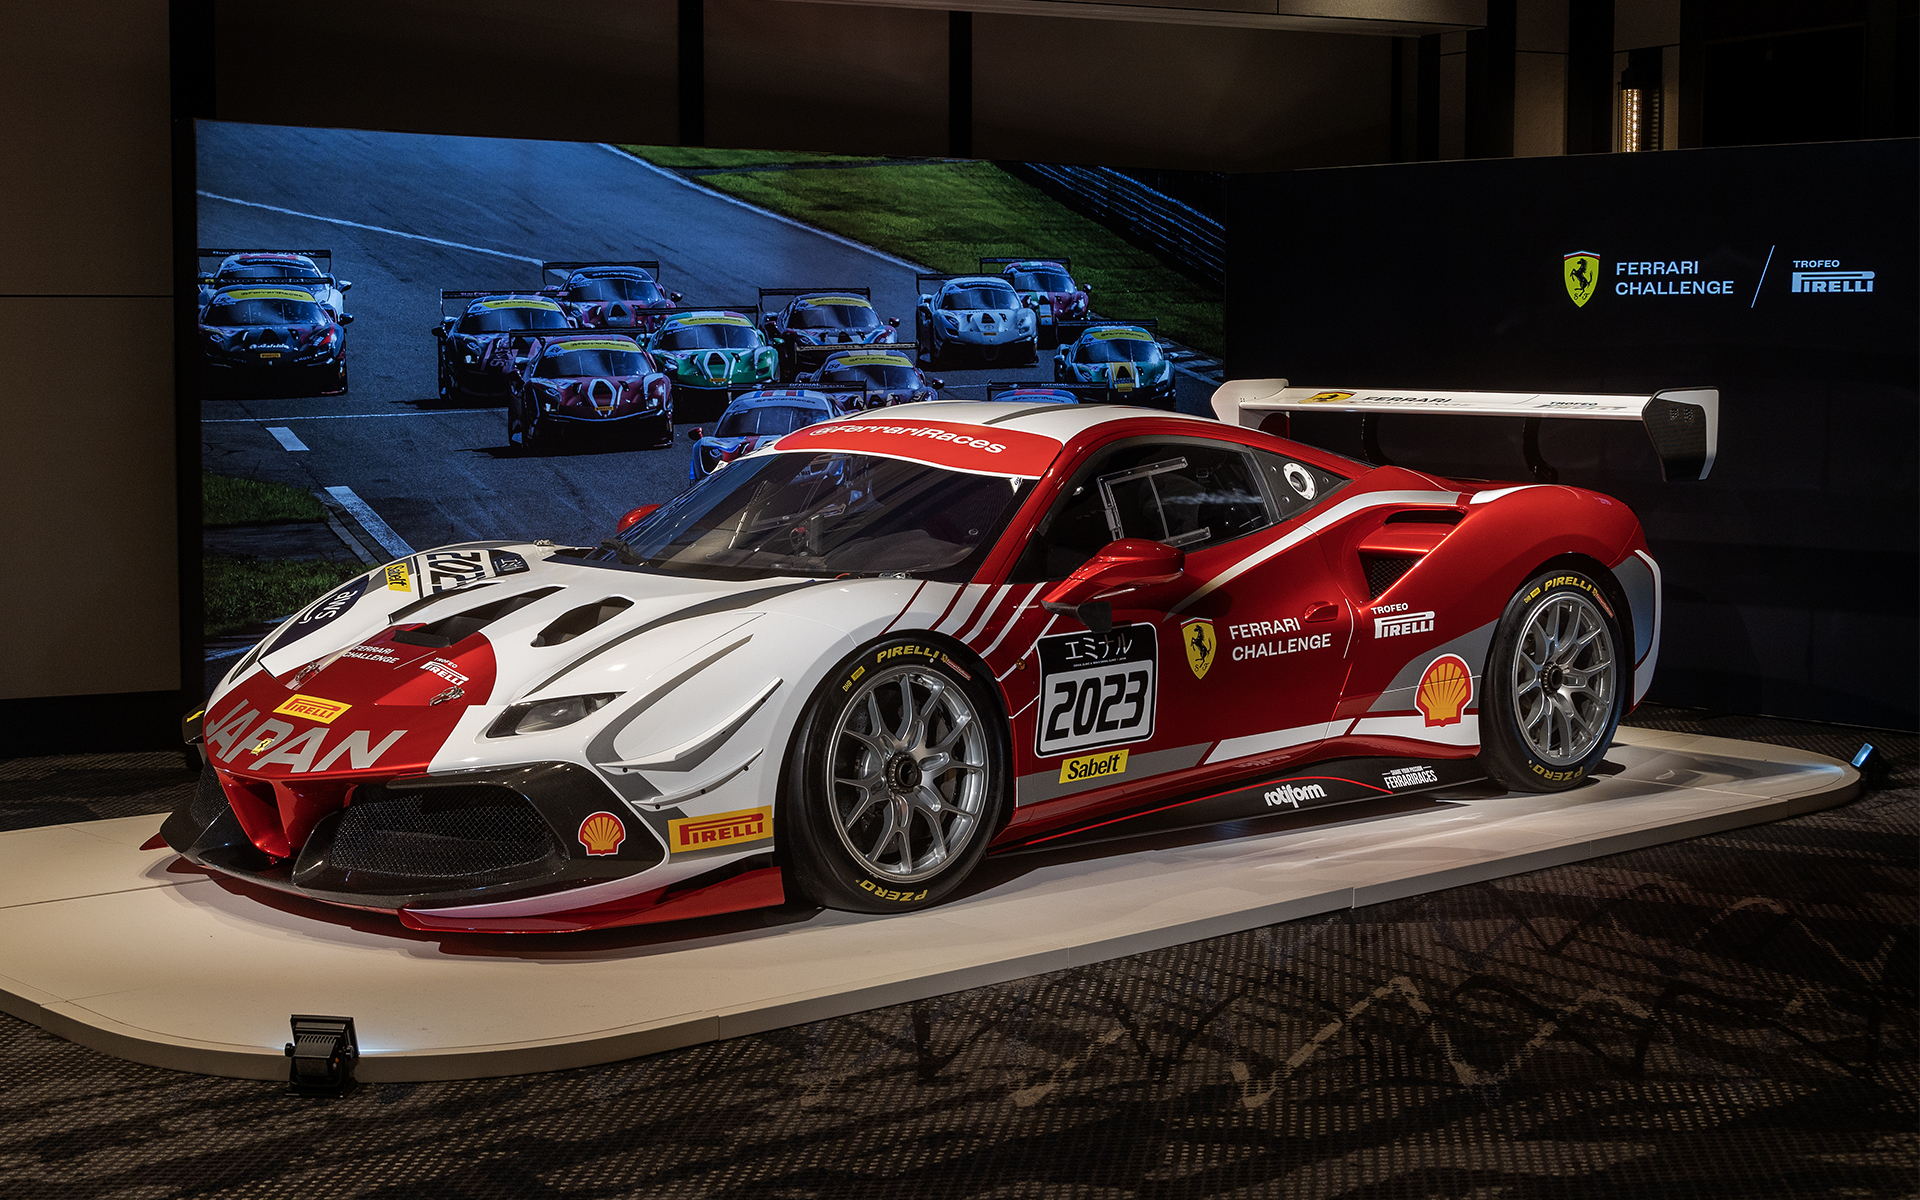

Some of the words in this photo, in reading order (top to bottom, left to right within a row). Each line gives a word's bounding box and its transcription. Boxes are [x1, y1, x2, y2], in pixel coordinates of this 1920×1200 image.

[1616, 260, 1700, 277] FERRARI
[1793, 259, 1841, 269] TROFEO
[1614, 280, 1735, 297] CHALLENGE
[1791, 270, 1877, 294] PIRELLI
[809, 424, 1007, 454] @FerrariRaces
[386, 564, 408, 587] Sabelt
[1544, 576, 1592, 592] PIRELLI
[314, 590, 359, 620] aws
[1370, 602, 1409, 616] TROFEO
[1228, 616, 1301, 640] FERRARI
[1374, 610, 1436, 640] PIRELLI
[342, 652, 400, 664] CHALLENGE
[876, 644, 940, 664] PIRELLI
[1064, 633, 1133, 660] エミナル
[1231, 632, 1332, 662] CHALLENGE
[419, 660, 470, 686] PIRELLI
[434, 657, 458, 669] TROFEO
[284, 698, 342, 719] PIRELLI
[1044, 669, 1149, 742] 2023
[205, 698, 409, 774] JAPAN
[1067, 753, 1122, 781] Sabelt
[1532, 764, 1584, 781] PZERO
[1383, 769, 1439, 789] FERRARIRACES
[1263, 783, 1328, 809] rotiform
[678, 812, 765, 846] PIRELLI
[859, 880, 929, 902] PZERO
